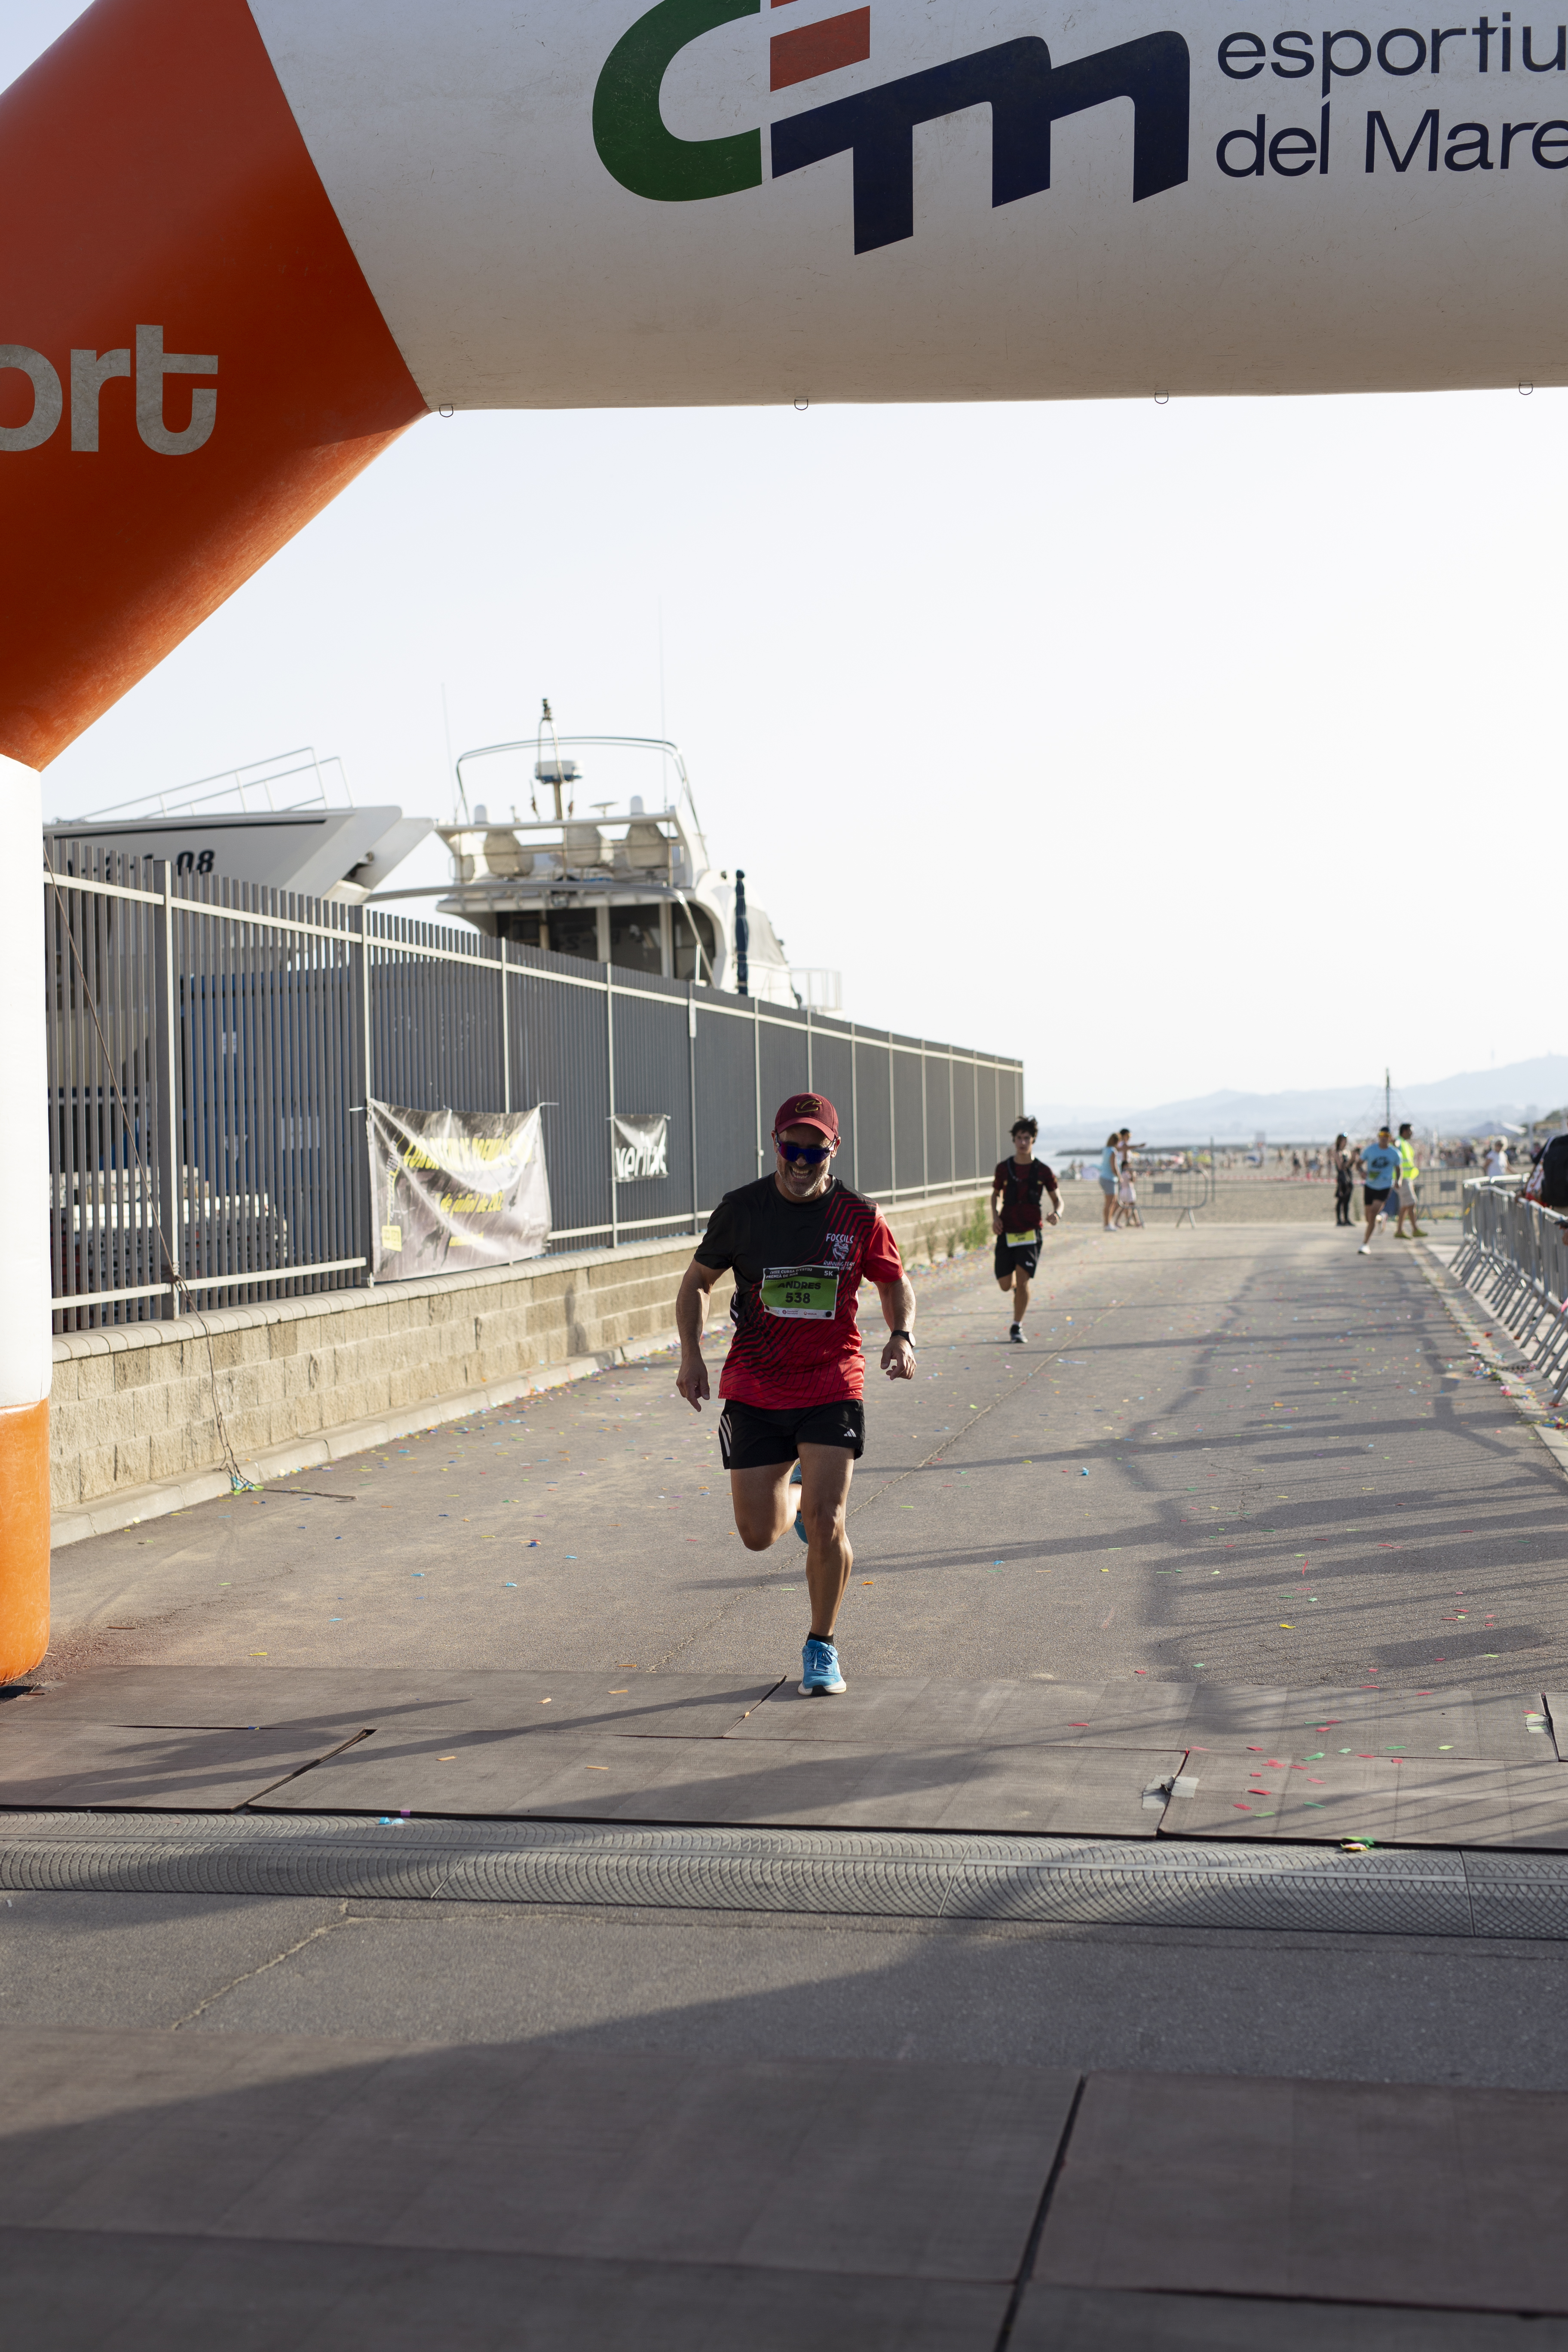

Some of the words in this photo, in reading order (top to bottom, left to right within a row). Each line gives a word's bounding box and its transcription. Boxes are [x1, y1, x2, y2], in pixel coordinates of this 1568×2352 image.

[1218, 12, 1567, 99] esportiu
[1216, 101, 1330, 178] del
[1365, 109, 1568, 172] Mare
[826, 1233, 854, 1244] FOSSILS
[777, 1280, 821, 1289] ANDRES
[785, 1292, 811, 1304] 538
